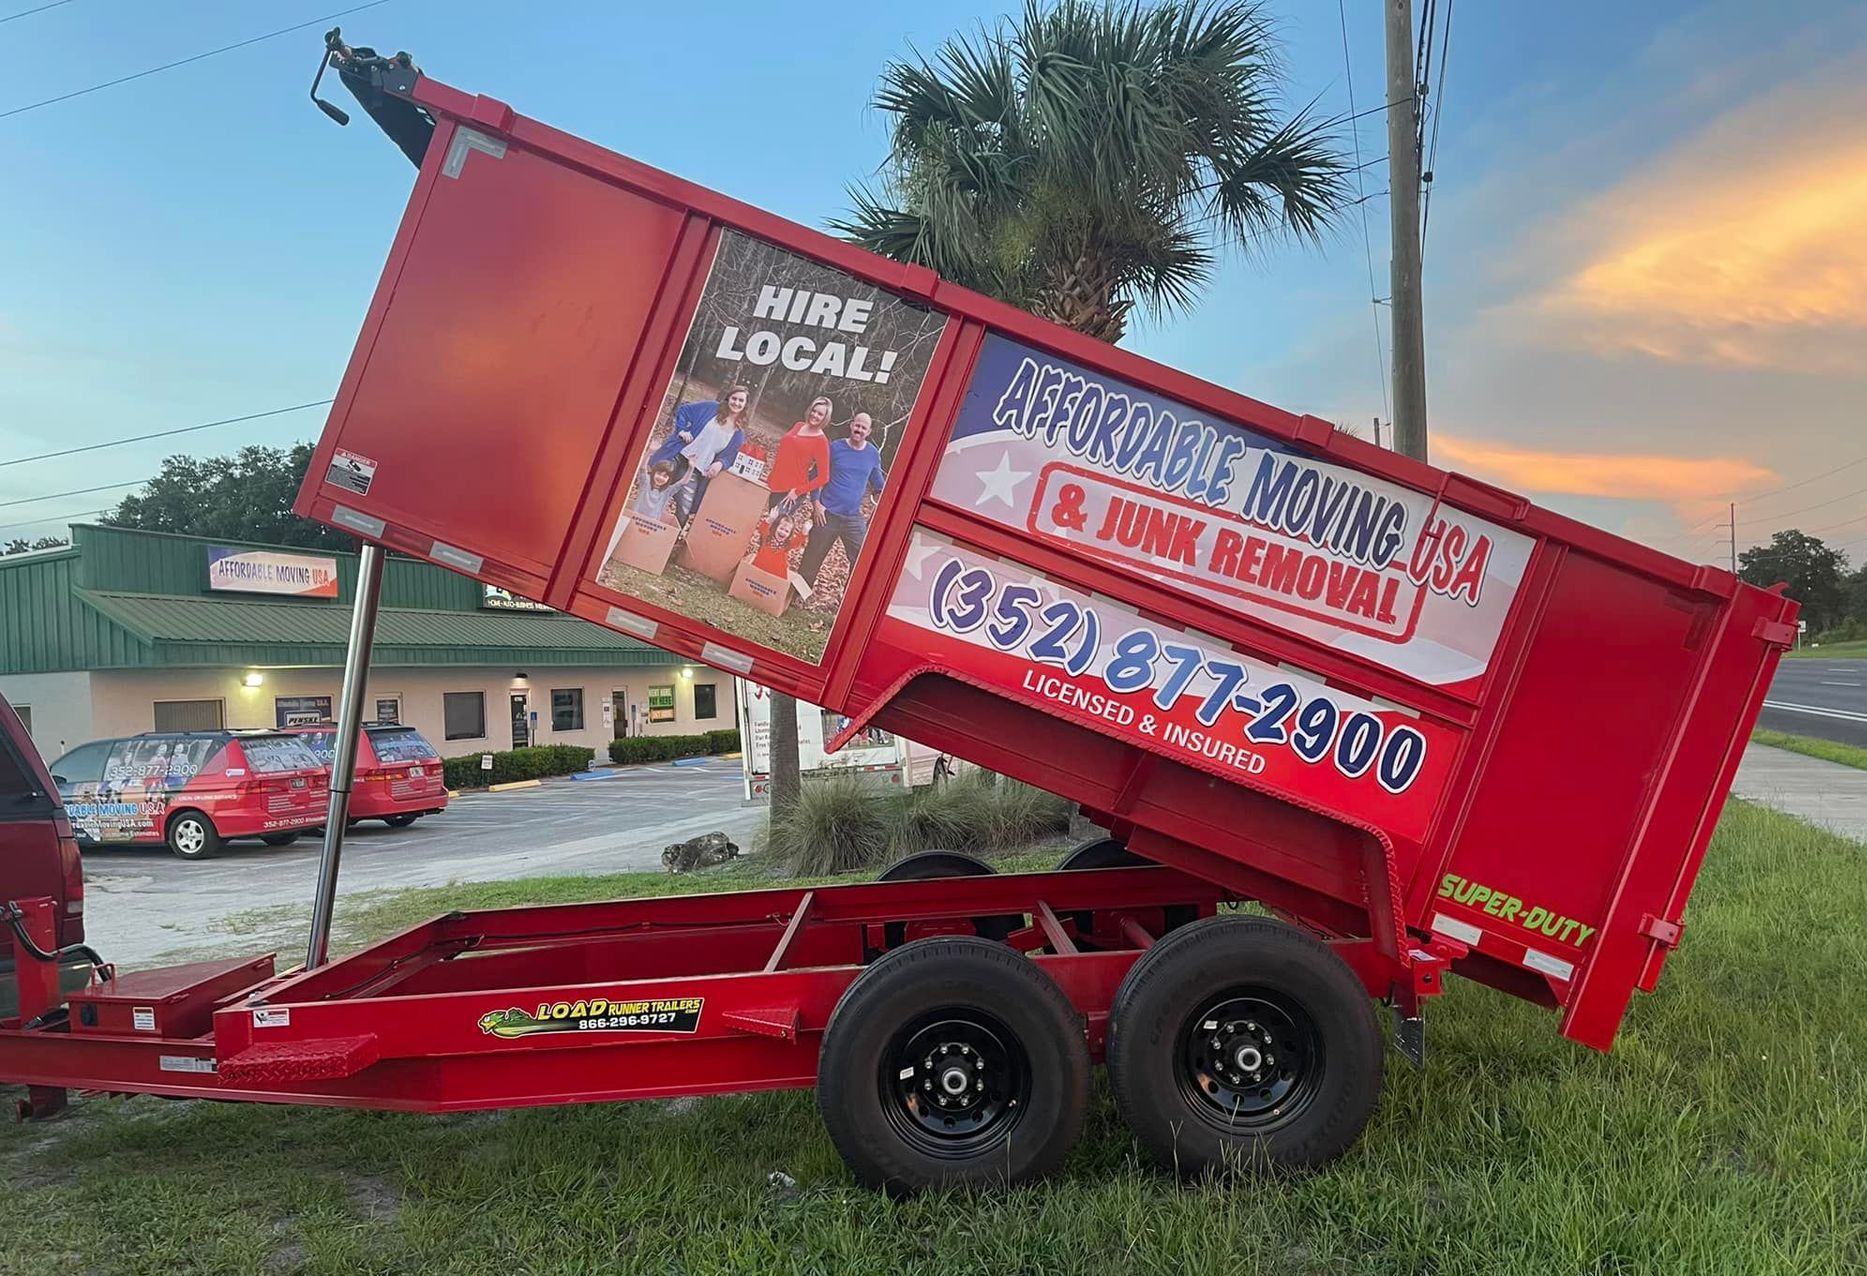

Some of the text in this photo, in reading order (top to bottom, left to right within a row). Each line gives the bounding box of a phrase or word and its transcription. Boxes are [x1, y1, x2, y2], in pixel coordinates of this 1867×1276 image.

[753, 284, 874, 334] HIRE
[715, 326, 898, 385] LOCAL!
[992, 356, 1492, 607] AFFORDABLE MOVING USA
[219, 561, 330, 586] AFFORDABLE MOVING USA
[1051, 483, 1400, 626] & JUNK REMOVAL
[928, 557, 1426, 794] (352) 877-2900
[1022, 669, 1266, 775] LICENSED & INSURED
[110, 764, 198, 777] 352-877-2900
[98, 803, 138, 816] MOVING
[1438, 873, 1595, 947] SUPER-DUTY
[537, 999, 700, 1021] LOAD RUNNER TRAILERS
